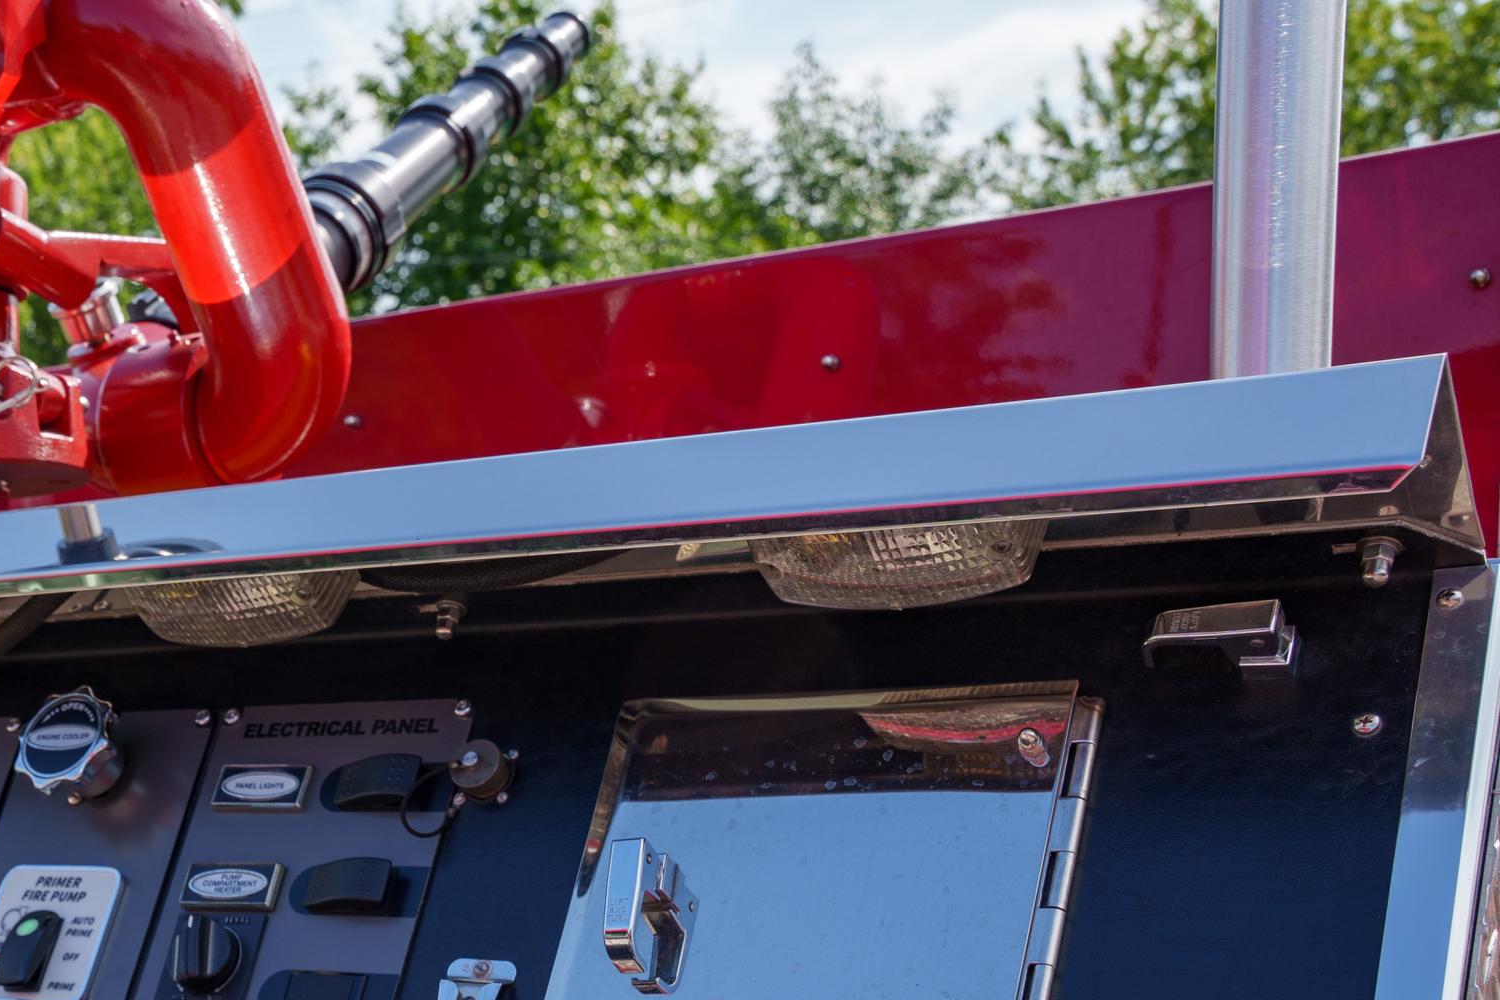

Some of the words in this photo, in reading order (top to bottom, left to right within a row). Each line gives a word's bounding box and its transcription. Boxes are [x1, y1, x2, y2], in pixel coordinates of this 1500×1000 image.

[61, 702, 85, 712] OPEN
[244, 721, 366, 739] ELECTRICAL
[372, 718, 439, 735] PANEL
[36, 876, 82, 888] PRIMER
[21, 890, 50, 902] FIRE
[50, 891, 87, 902] PUMP
[71, 917, 95, 925] AUTO
[65, 929, 94, 937] PRIME
[62, 953, 81, 961] OFF
[47, 982, 76, 991] PRIME
